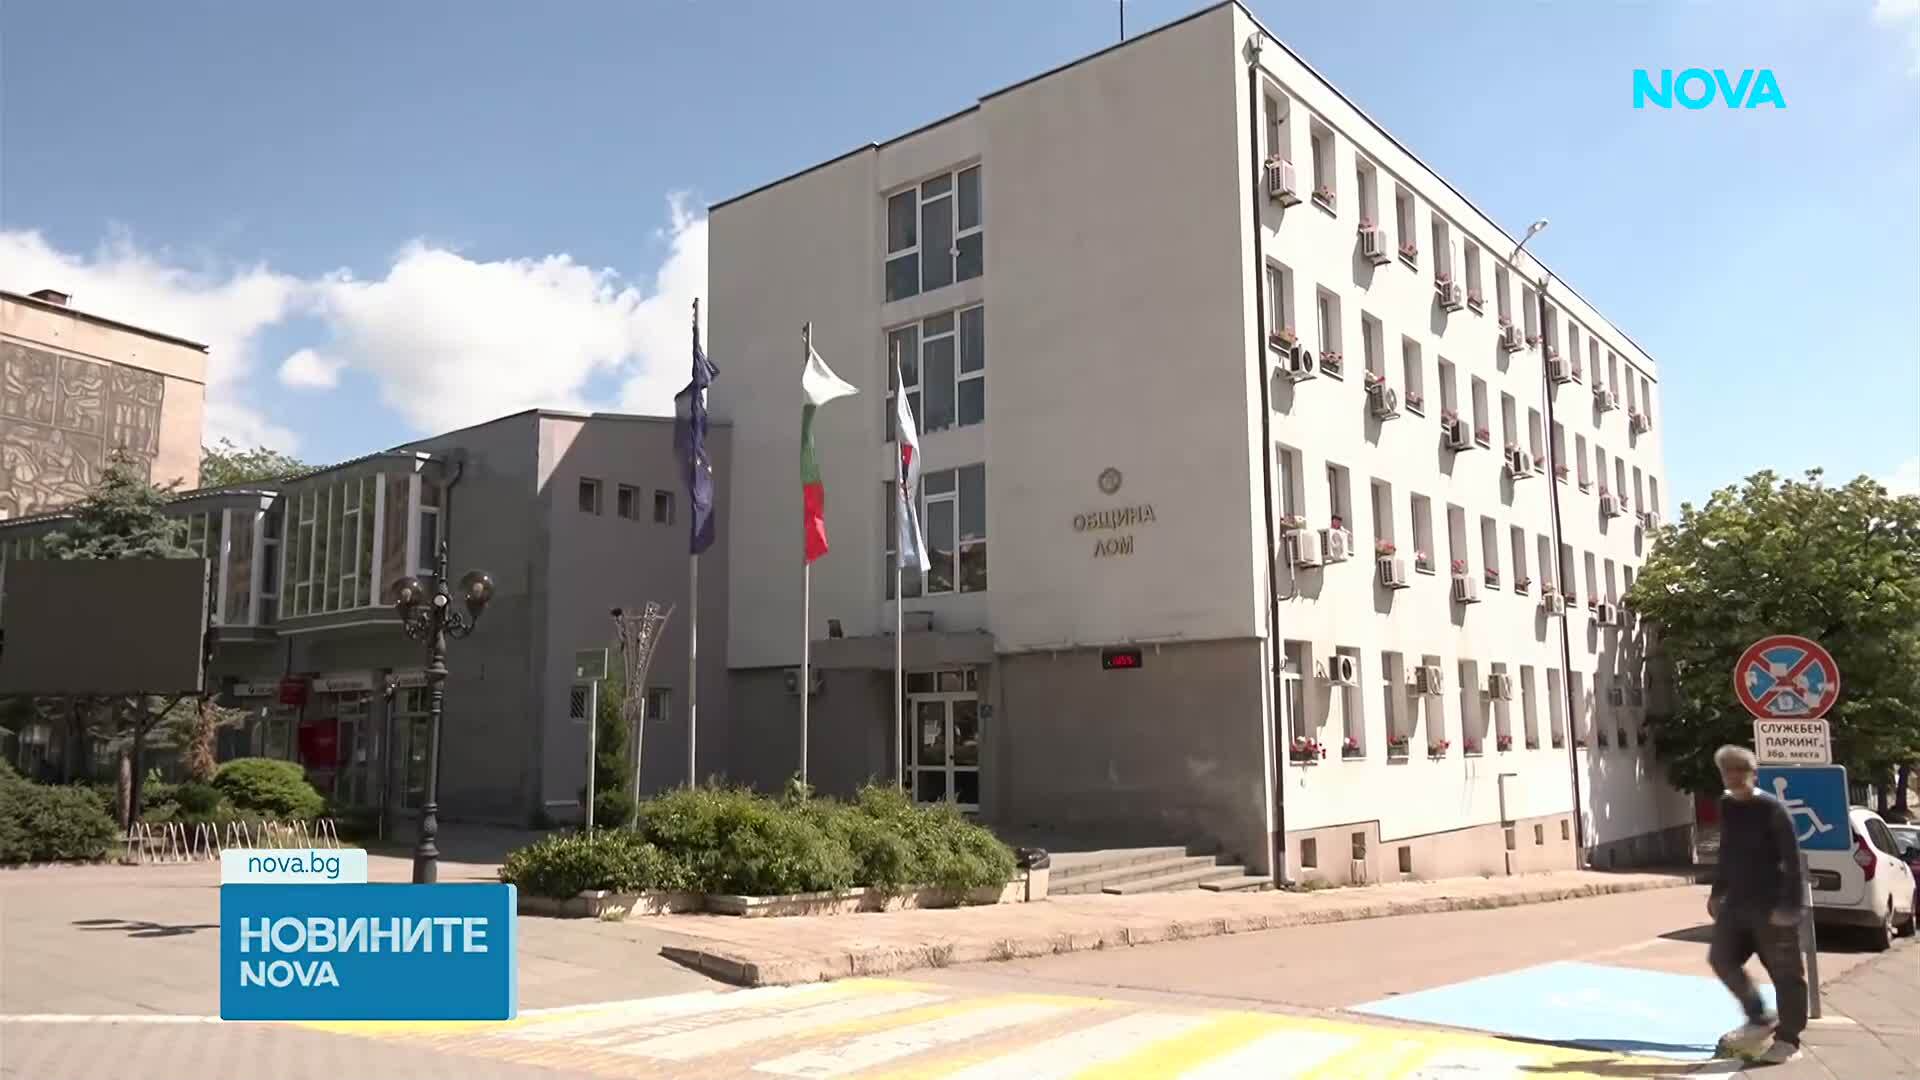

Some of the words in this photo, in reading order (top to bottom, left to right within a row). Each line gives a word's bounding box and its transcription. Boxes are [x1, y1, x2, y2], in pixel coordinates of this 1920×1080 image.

[1073, 504, 1156, 531] ОБЩИНА
[1094, 535, 1134, 558] ЛОМ
[1760, 723, 1822, 734] СЛУЖЕБЕН
